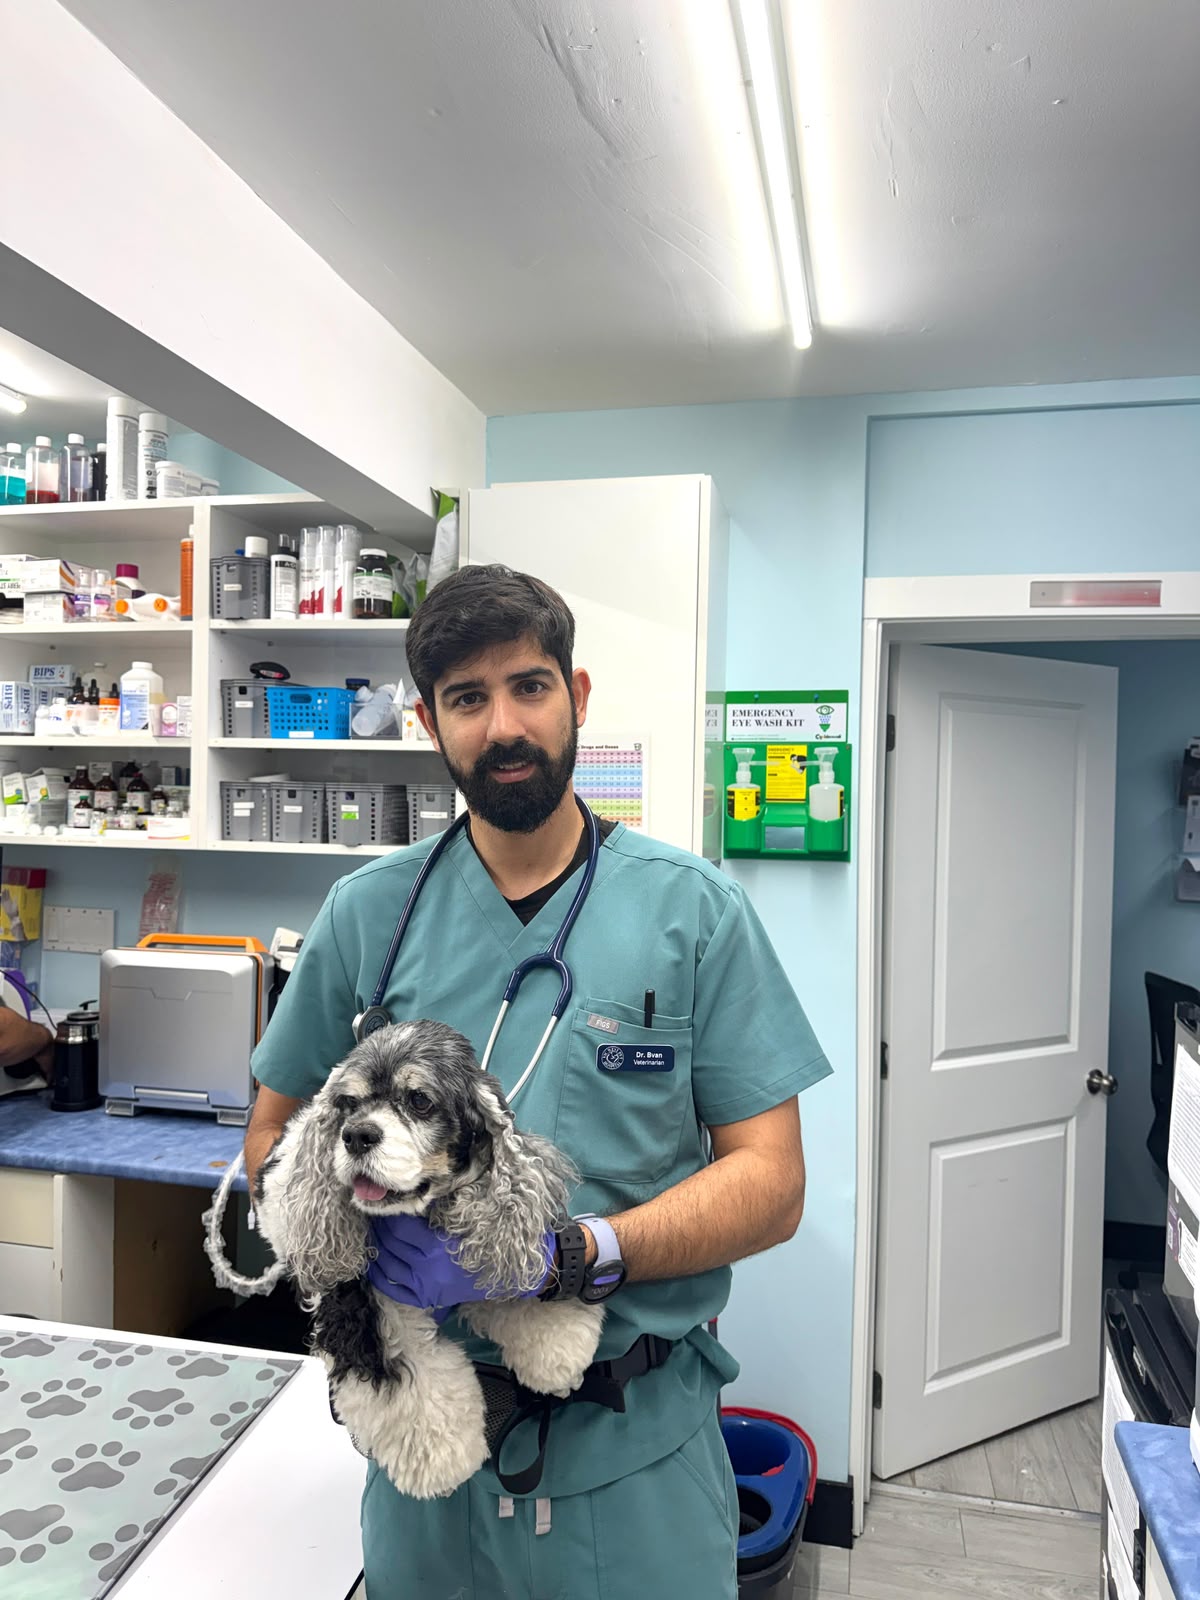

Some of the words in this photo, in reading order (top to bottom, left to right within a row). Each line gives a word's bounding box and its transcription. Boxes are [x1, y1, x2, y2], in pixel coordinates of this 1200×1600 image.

[34, 667, 56, 677] BIPS
[4, 684, 13, 709] BIPS
[23, 689, 31, 714] BIPS
[732, 709, 795, 718] EMERGENCY
[732, 719, 751, 727] EYE
[754, 719, 782, 727] WASH
[786, 719, 805, 727] KIT
[596, 1020, 610, 1029] FIGS
